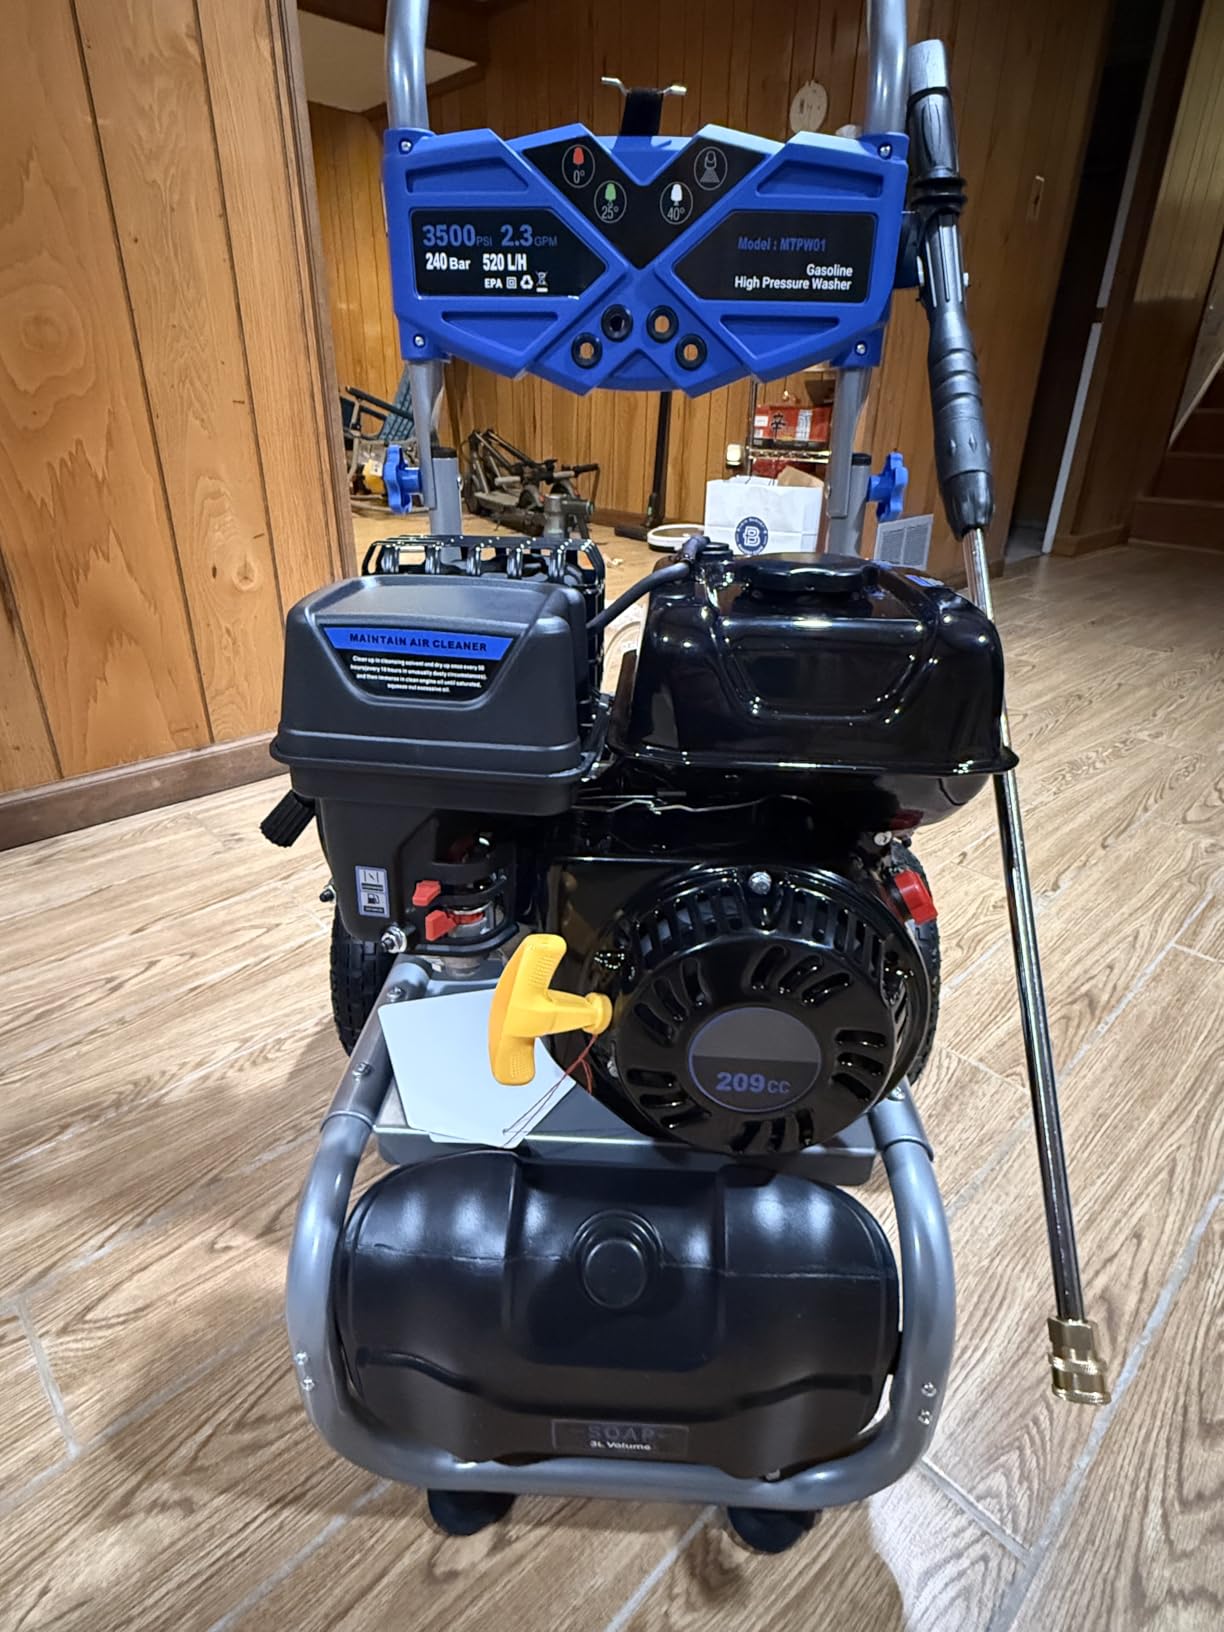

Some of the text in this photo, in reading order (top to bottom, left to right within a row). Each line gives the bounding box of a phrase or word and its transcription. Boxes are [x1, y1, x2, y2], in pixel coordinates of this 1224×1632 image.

[738, 236, 771, 250] Model
[780, 238, 826, 251] MTPW01
[449, 257, 470, 271] Bar
[483, 253, 504, 271] 520
[507, 253, 527, 272] L/H
[806, 264, 853, 277] Gasoline
[484, 278, 502, 289] EPA
[734, 276, 852, 290] High Pressure Washer
[350, 633, 487, 652] MAINTAIN AIR CLEANER
[588, 1424, 654, 1441] SOAP
[607, 1441, 651, 1451] Volume
